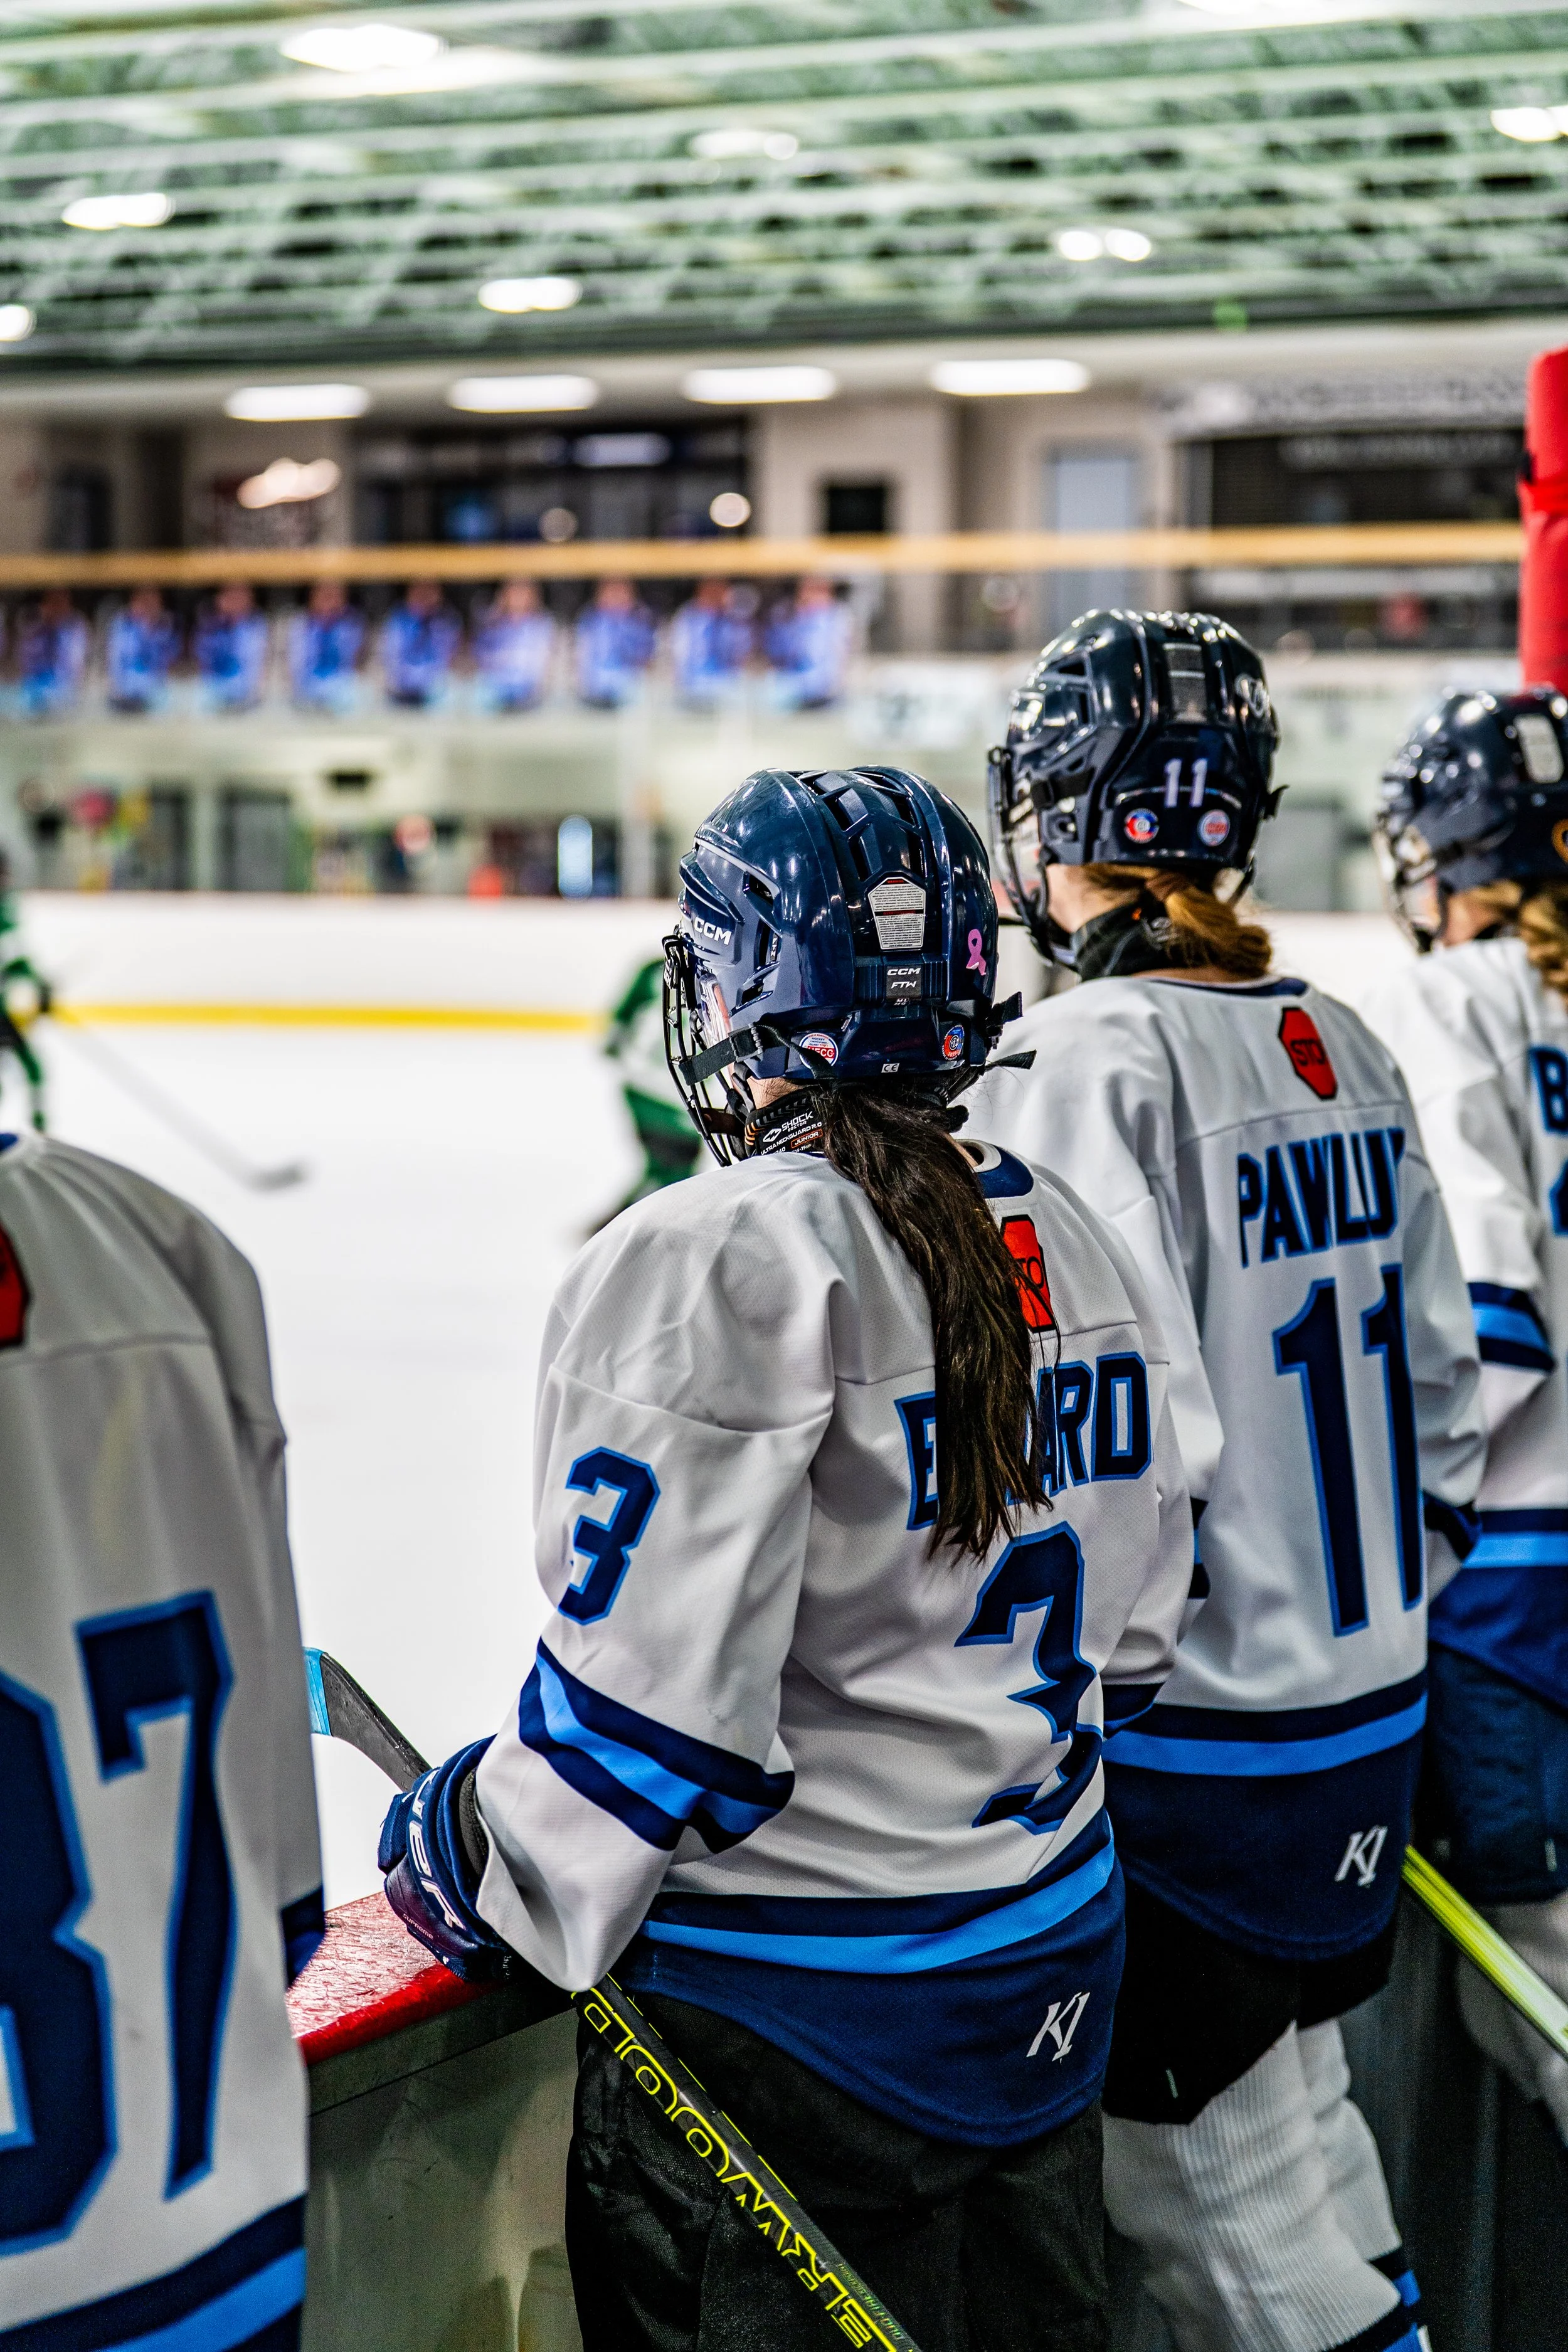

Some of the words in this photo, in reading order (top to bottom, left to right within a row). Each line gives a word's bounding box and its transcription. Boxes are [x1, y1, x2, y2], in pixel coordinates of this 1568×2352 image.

[1164, 758, 1207, 808] 11
[694, 916, 732, 945] CCM
[887, 967, 921, 976] CCM
[891, 980, 917, 989] FTW
[884, 1064, 898, 1072] CE
[781, 1111, 813, 1131] SHOCK
[787, 1121, 807, 1132] DOCTOR
[761, 1143, 777, 1155] ULTRA
[776, 1126, 811, 1147] NECKGUARD
[794, 1131, 819, 1145] JUNIOR
[1271, 1263, 1424, 1637] 11
[558, 1446, 661, 1626] 3
[402, 1913, 433, 1939] SUPREME
